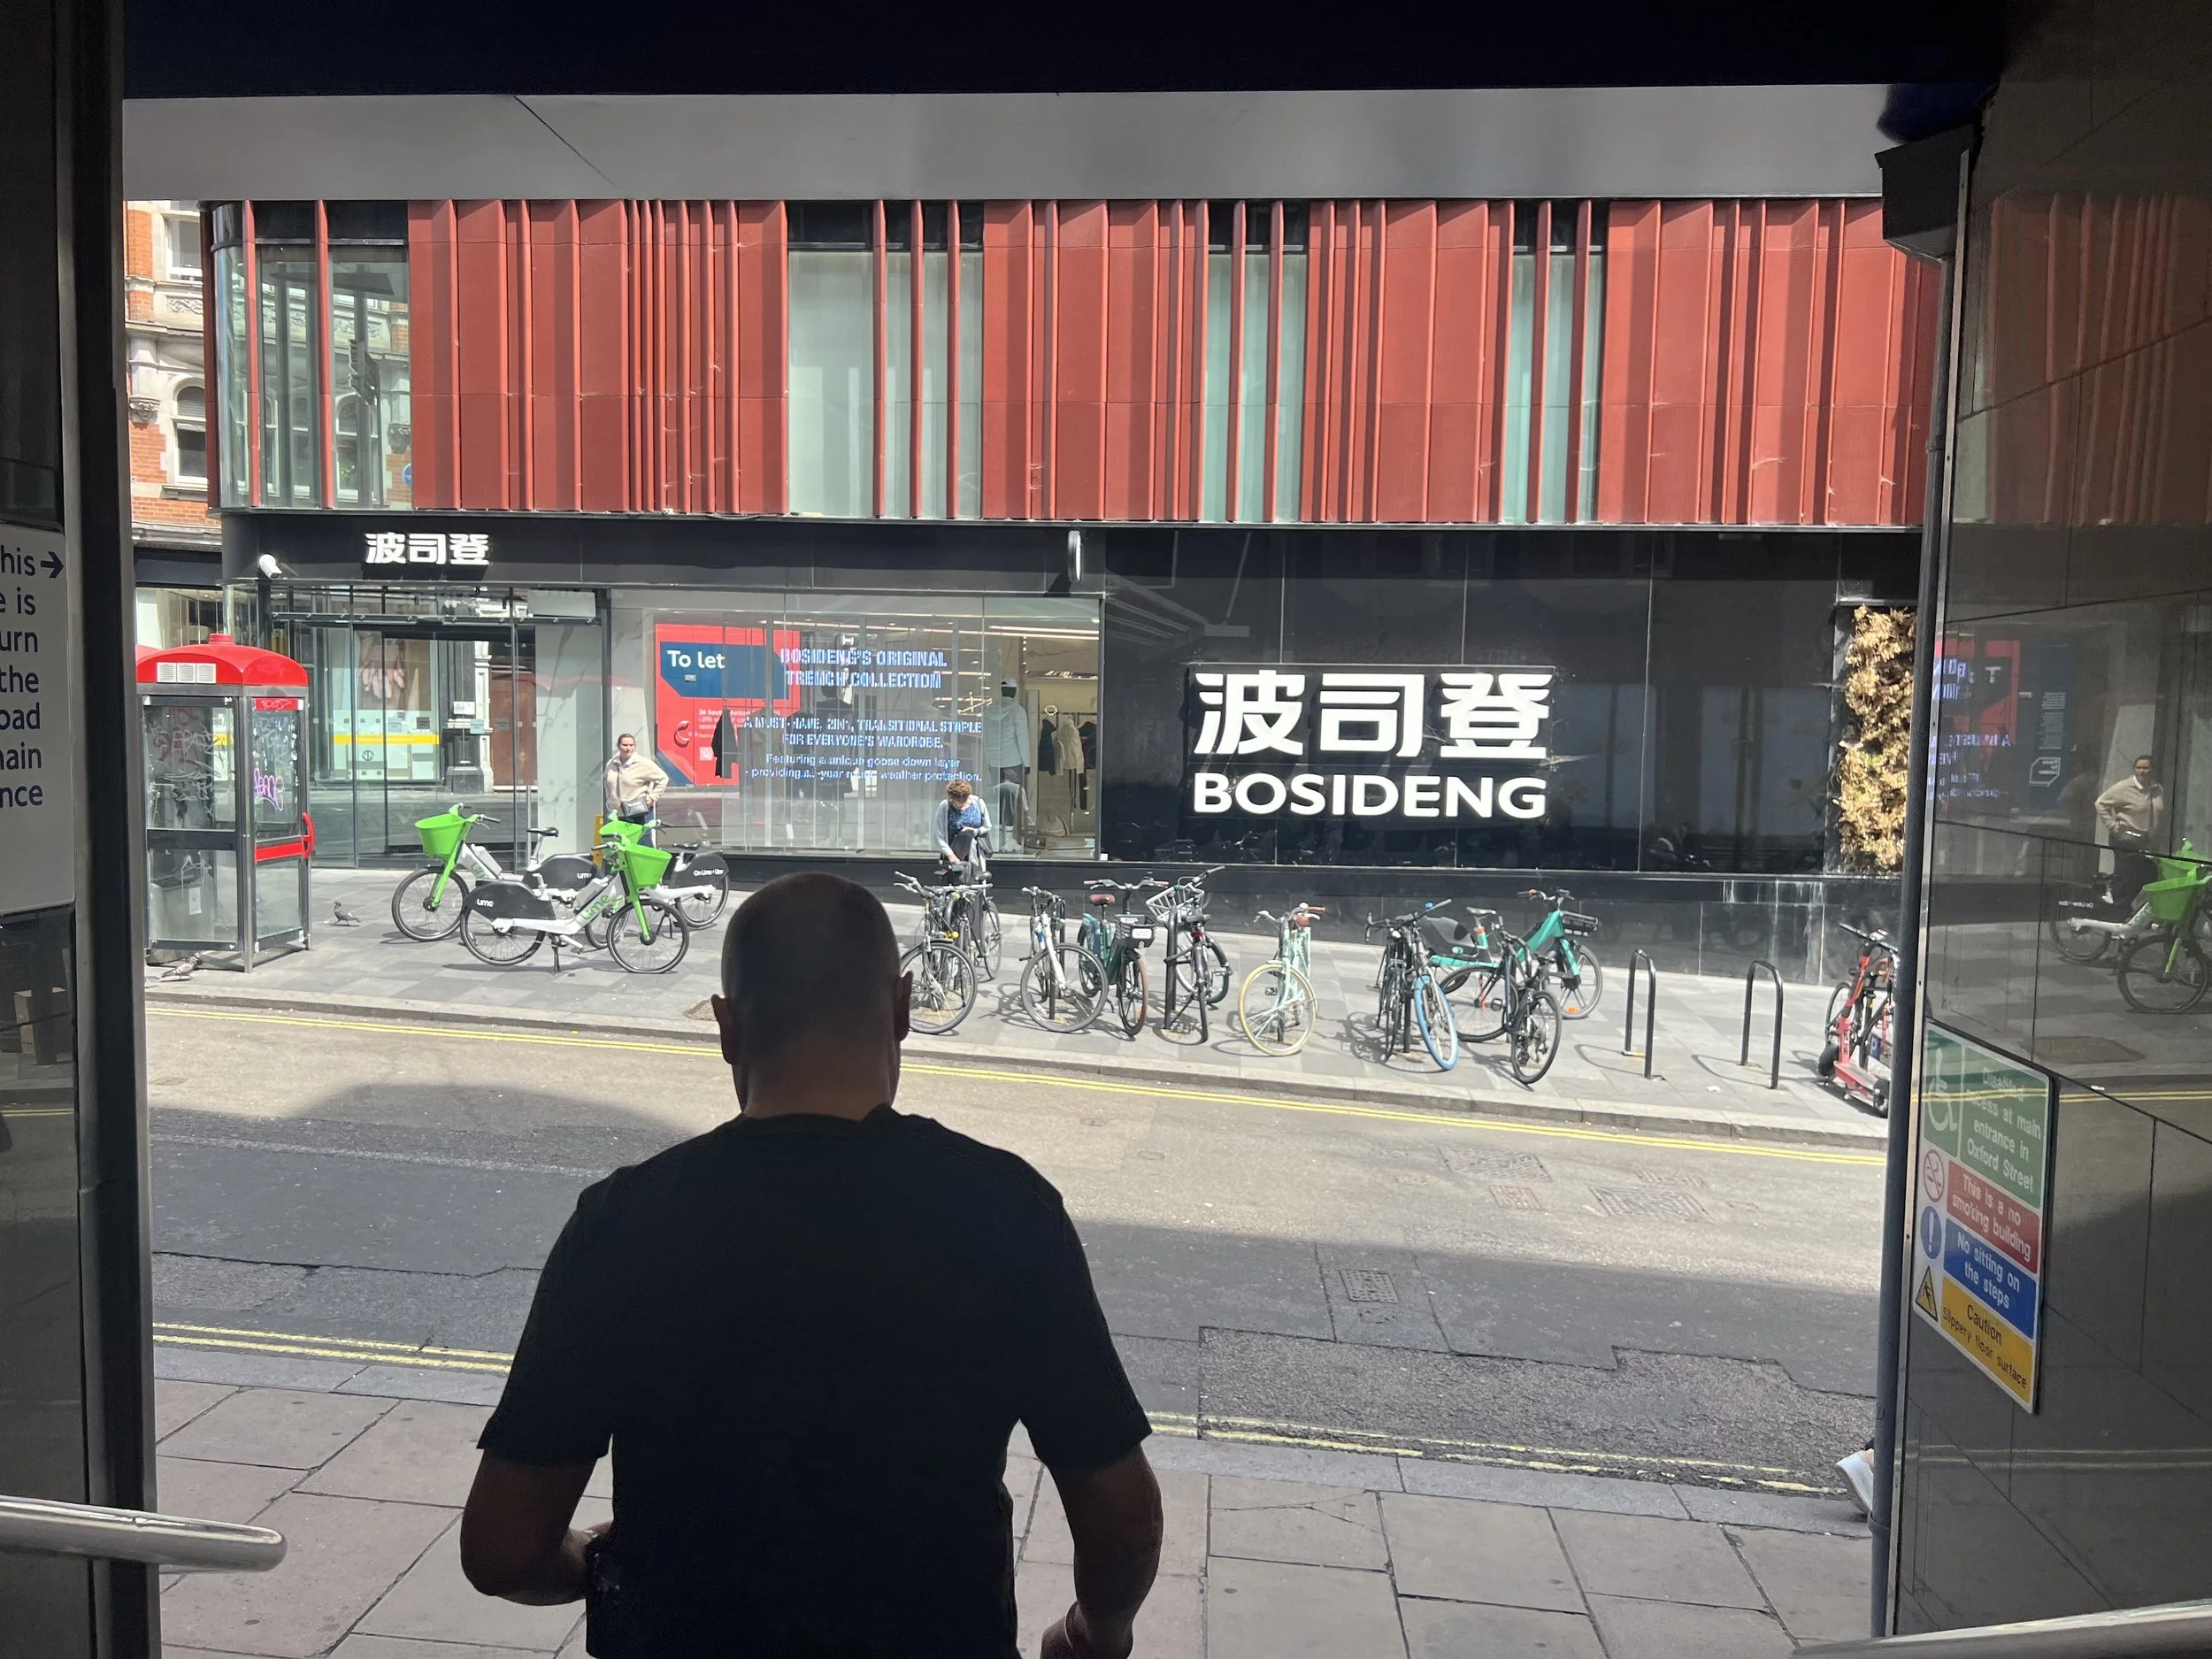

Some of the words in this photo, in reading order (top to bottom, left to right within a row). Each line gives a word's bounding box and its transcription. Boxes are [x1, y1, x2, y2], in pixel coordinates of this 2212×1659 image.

[0, 544, 36, 576] his
[365, 532, 490, 565] 波司登
[17, 586, 36, 616] is
[0, 630, 39, 653] urn
[666, 649, 692, 668] To
[697, 650, 726, 670] let
[876, 650, 948, 667] ORIGINAL
[0, 664, 39, 694] the
[786, 670, 847, 687] TRENCH
[849, 672, 942, 688] COLLECTION
[0, 702, 41, 731] oad
[940, 721, 982, 733] STAPLE
[1194, 669, 1553, 759] 波司登
[782, 733, 804, 745] FOR
[806, 733, 874, 747] EVERYONE'S
[0, 741, 42, 771] ain
[766, 753, 816, 766] Featuring
[867, 757, 900, 768] goose
[902, 757, 932, 767] down
[0, 785, 43, 808] nce
[1194, 772, 1547, 818] BOSIDENG
[580, 894, 611, 921] Lime
[2002, 1107, 2013, 1125] at
[2016, 1115, 2041, 1140] main
[1973, 1119, 2016, 1154] entrance
[2019, 1139, 2029, 1162] in
[1967, 1138, 1999, 1171] Oxford
[2002, 1158, 2034, 1193] Street
[1962, 1173, 1981, 1201] This
[1985, 1187, 1993, 1209] is
[1997, 1200, 2004, 1216] a
[2008, 1206, 2021, 1226] no
[1952, 1194, 1990, 1233] smoking
[1993, 1217, 2032, 1263] building
[1957, 1231, 1970, 1255] No
[1973, 1246, 2004, 1283] sitting
[2007, 1271, 2020, 1293] on
[1964, 1260, 1979, 1285] the
[1983, 1278, 2010, 1309] steps
[1966, 1303, 2002, 1346] Caution
[1942, 1306, 1971, 1343] Slippery
[1995, 1355, 2027, 1389] surface
